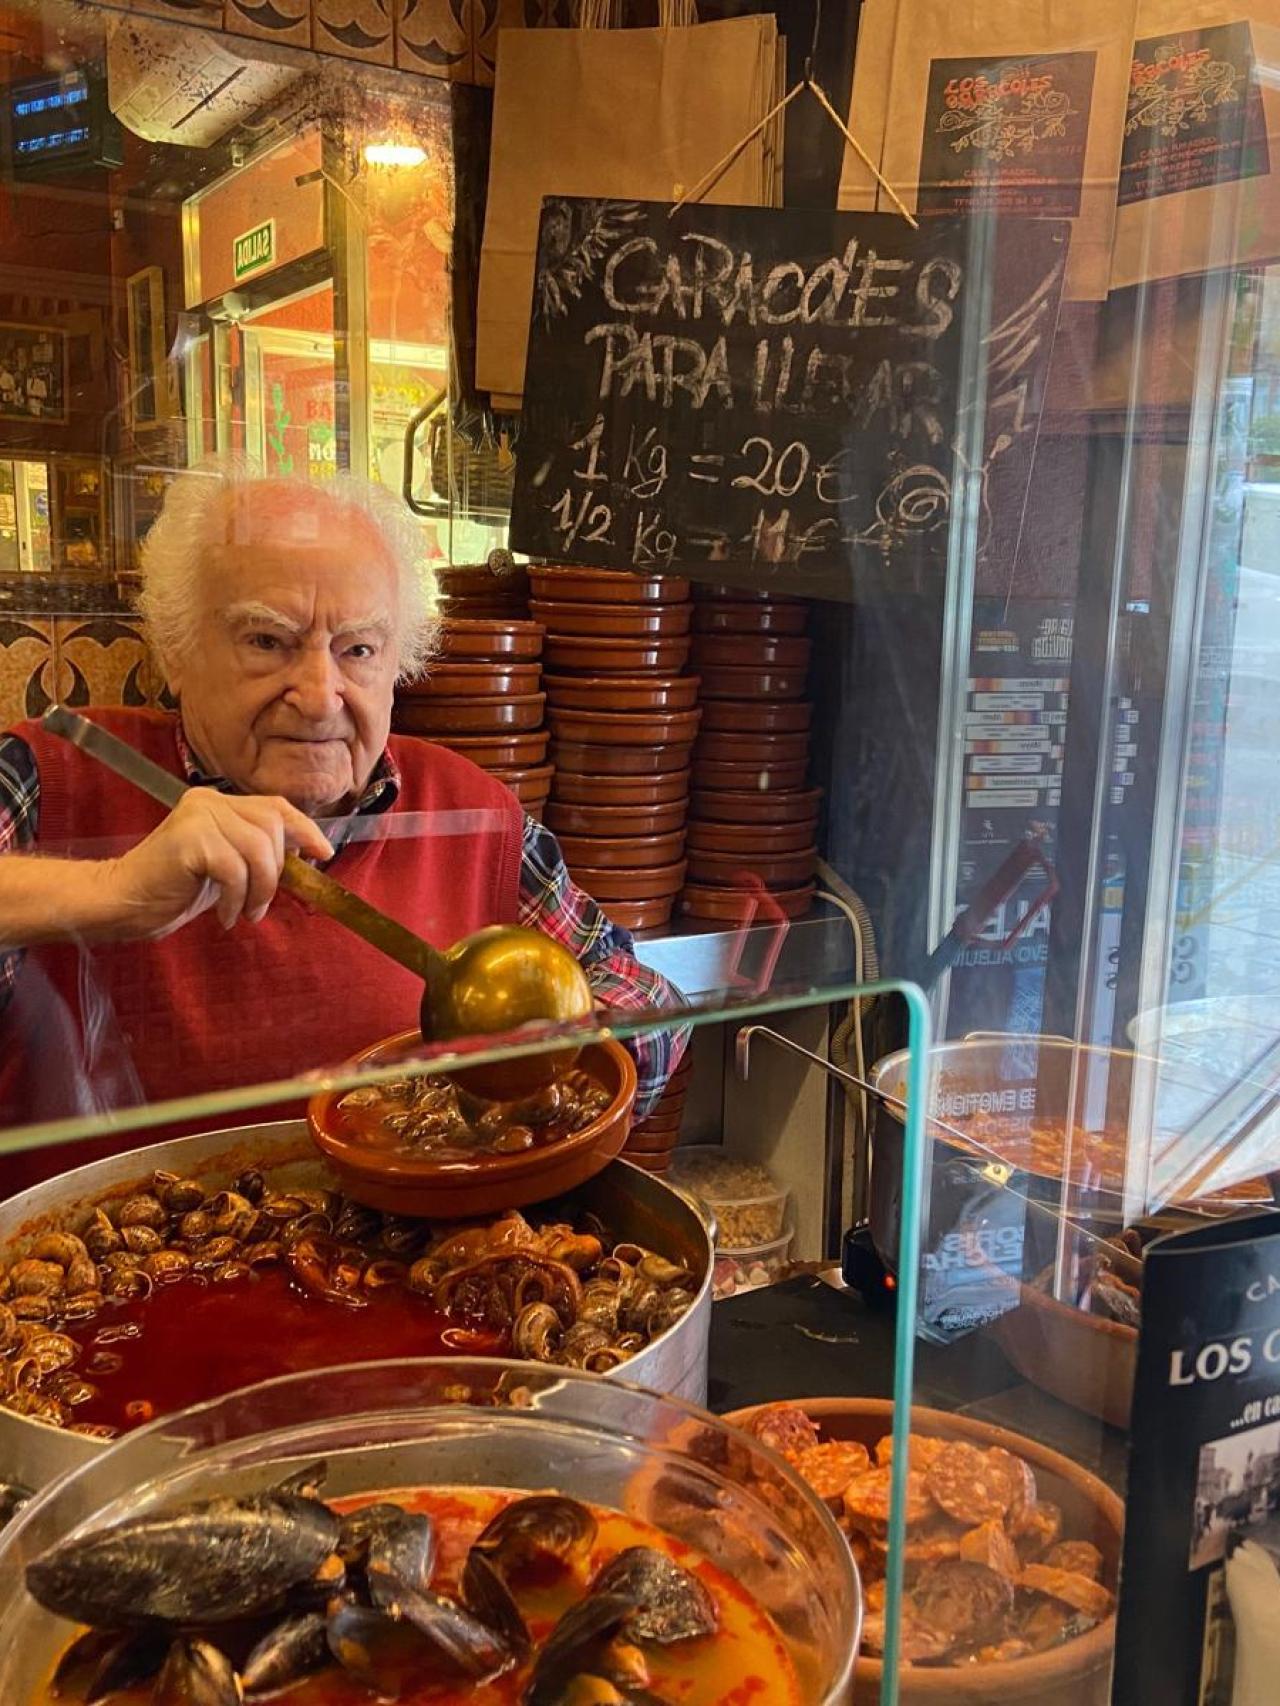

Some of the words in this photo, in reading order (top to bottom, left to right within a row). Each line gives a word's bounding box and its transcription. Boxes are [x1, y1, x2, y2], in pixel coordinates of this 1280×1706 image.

[585, 323, 735, 410] PARA
[568, 412, 609, 482] 1
[549, 488, 616, 552] 1/2
[1168, 1337, 1253, 1386] LOS
